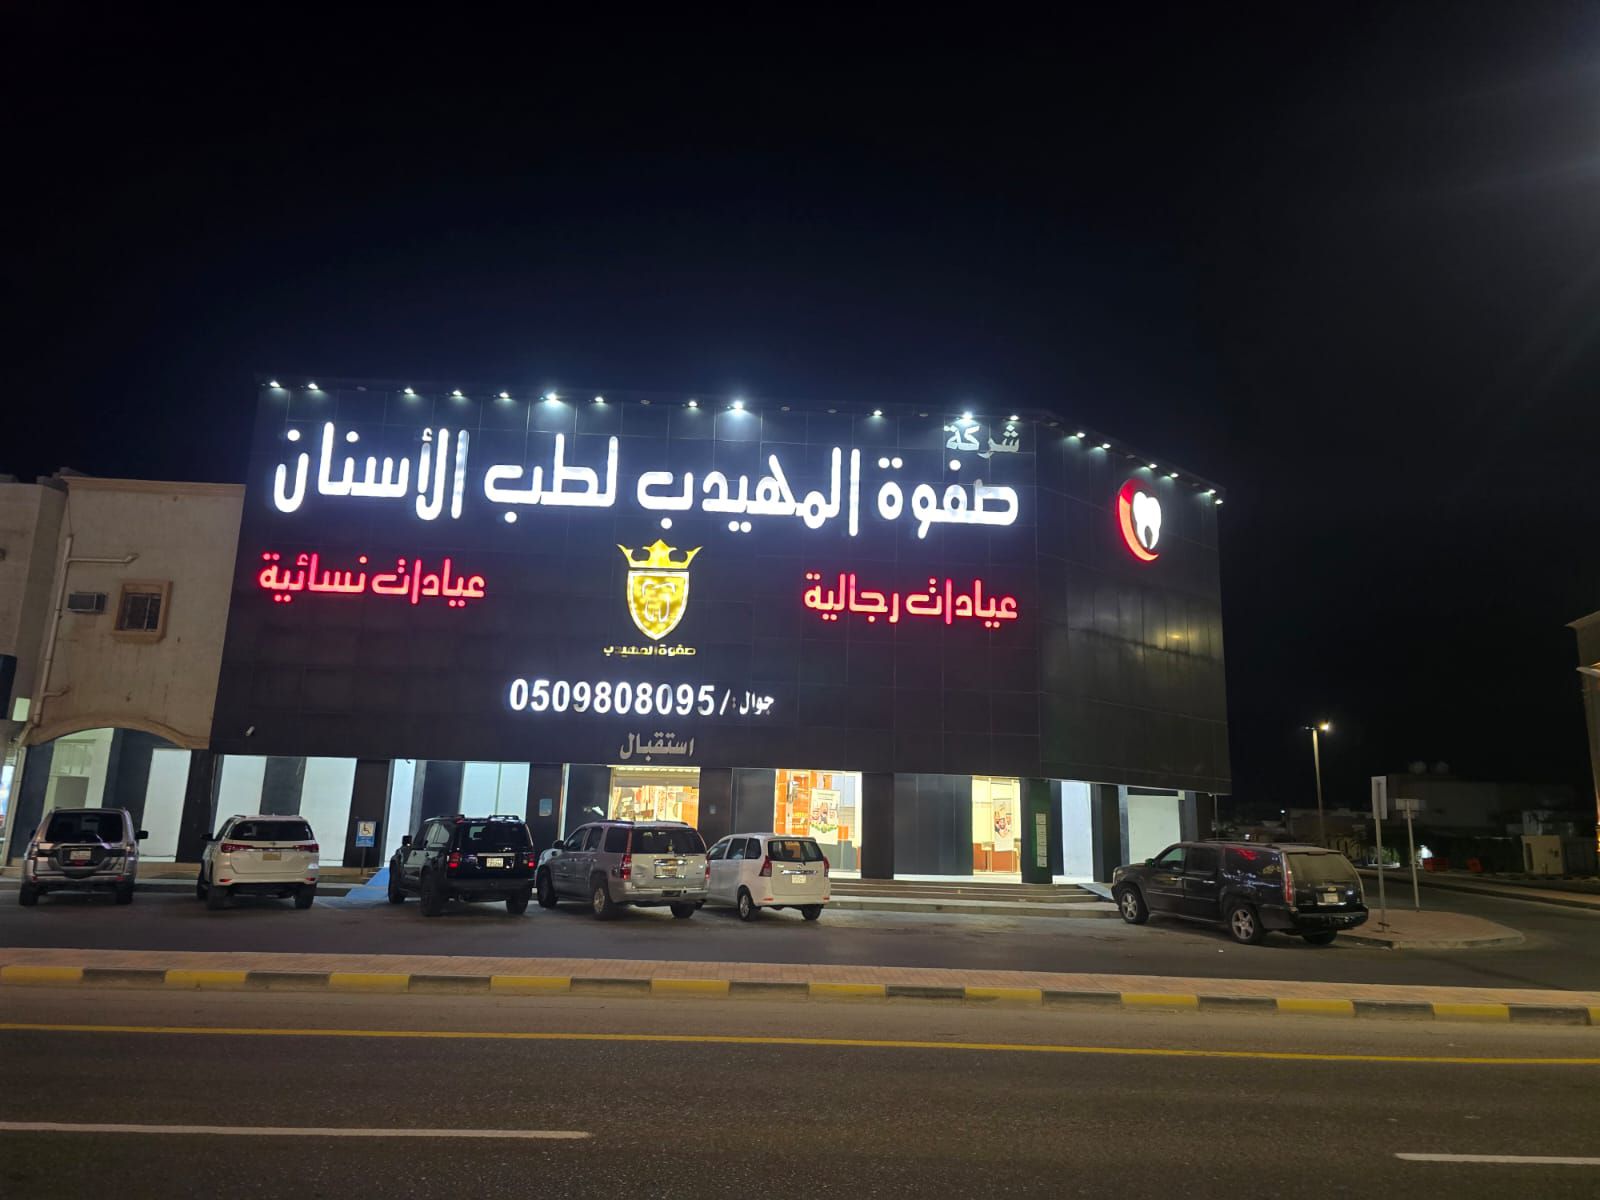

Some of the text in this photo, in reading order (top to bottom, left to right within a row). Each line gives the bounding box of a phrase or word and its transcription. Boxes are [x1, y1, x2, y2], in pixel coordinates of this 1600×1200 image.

[943, 425, 1019, 459] شركة
[274, 422, 1019, 539] صفوة المهيدب لطب الأسنان
[258, 553, 486, 608] عيادات نسائية
[804, 573, 1018, 629] عيادات رجالية
[509, 678, 716, 716] 0509808095
[620, 732, 695, 762] استقبال
